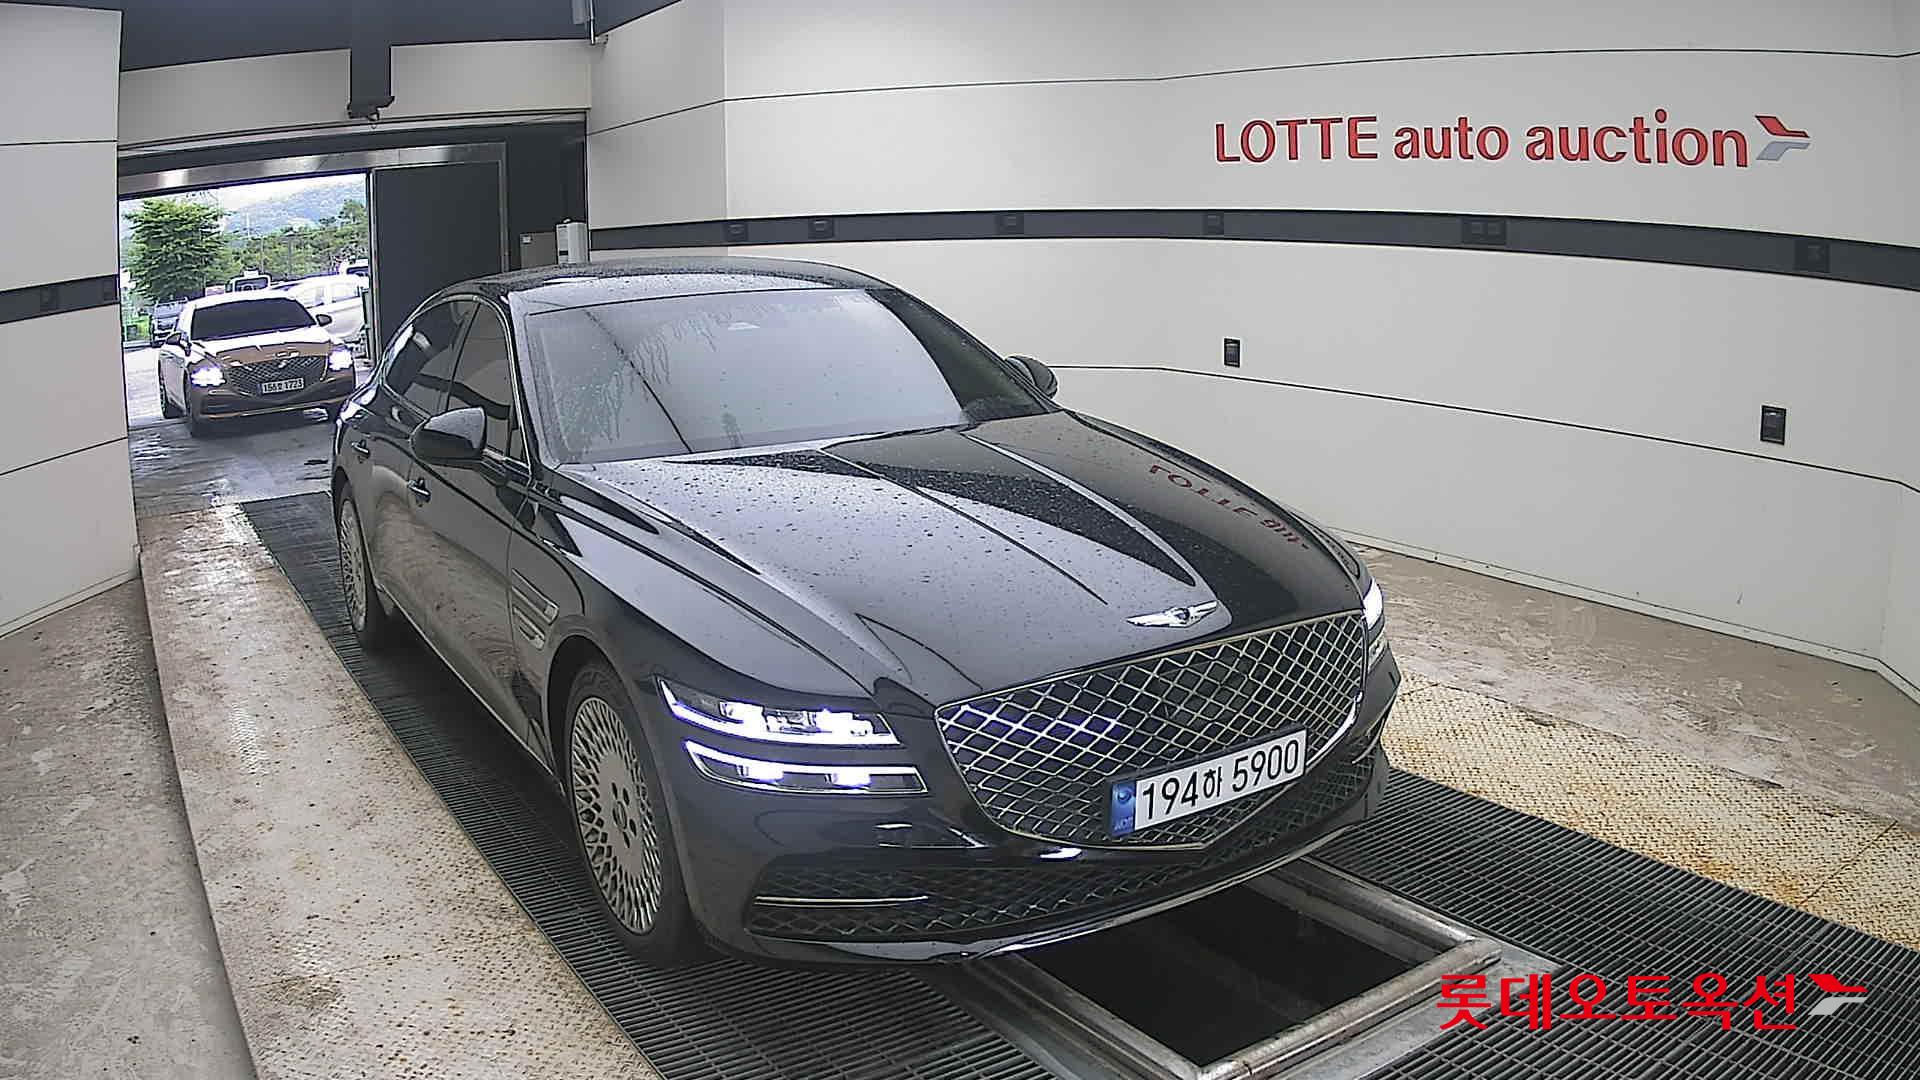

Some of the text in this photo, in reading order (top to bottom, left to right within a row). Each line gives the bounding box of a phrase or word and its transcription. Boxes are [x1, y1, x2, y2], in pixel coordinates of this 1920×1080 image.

[1215, 110, 1751, 168] LOTTE auto auction
[1142, 739, 1299, 820] 194하 5900
